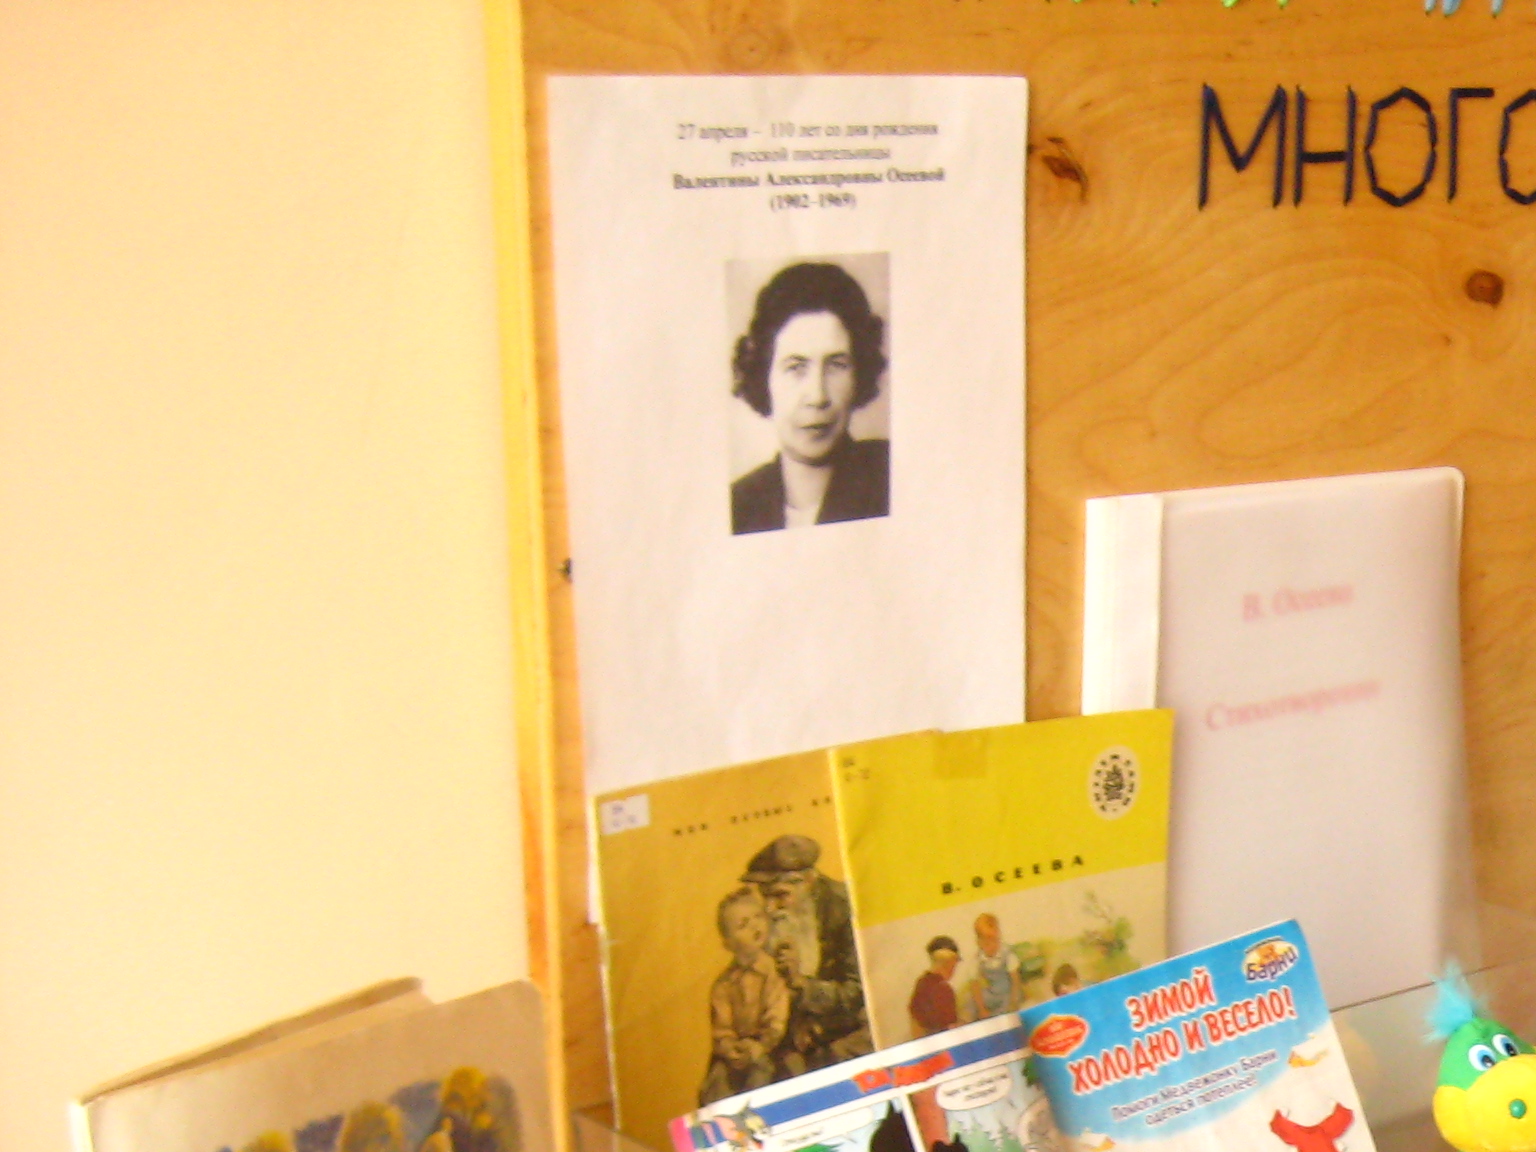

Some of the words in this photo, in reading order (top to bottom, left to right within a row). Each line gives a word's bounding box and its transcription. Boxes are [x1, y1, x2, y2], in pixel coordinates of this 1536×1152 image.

[941, 881, 960, 895] В.
[971, 854, 1084, 888] ОСЕЕВА
[1246, 945, 1299, 982] Барни
[1127, 967, 1216, 1030] ЗИМОЙ
[1069, 1027, 1181, 1093] ХОЛОДНО
[1184, 1020, 1205, 1052] И
[1204, 986, 1296, 1043] ВЕСЕЛО!
